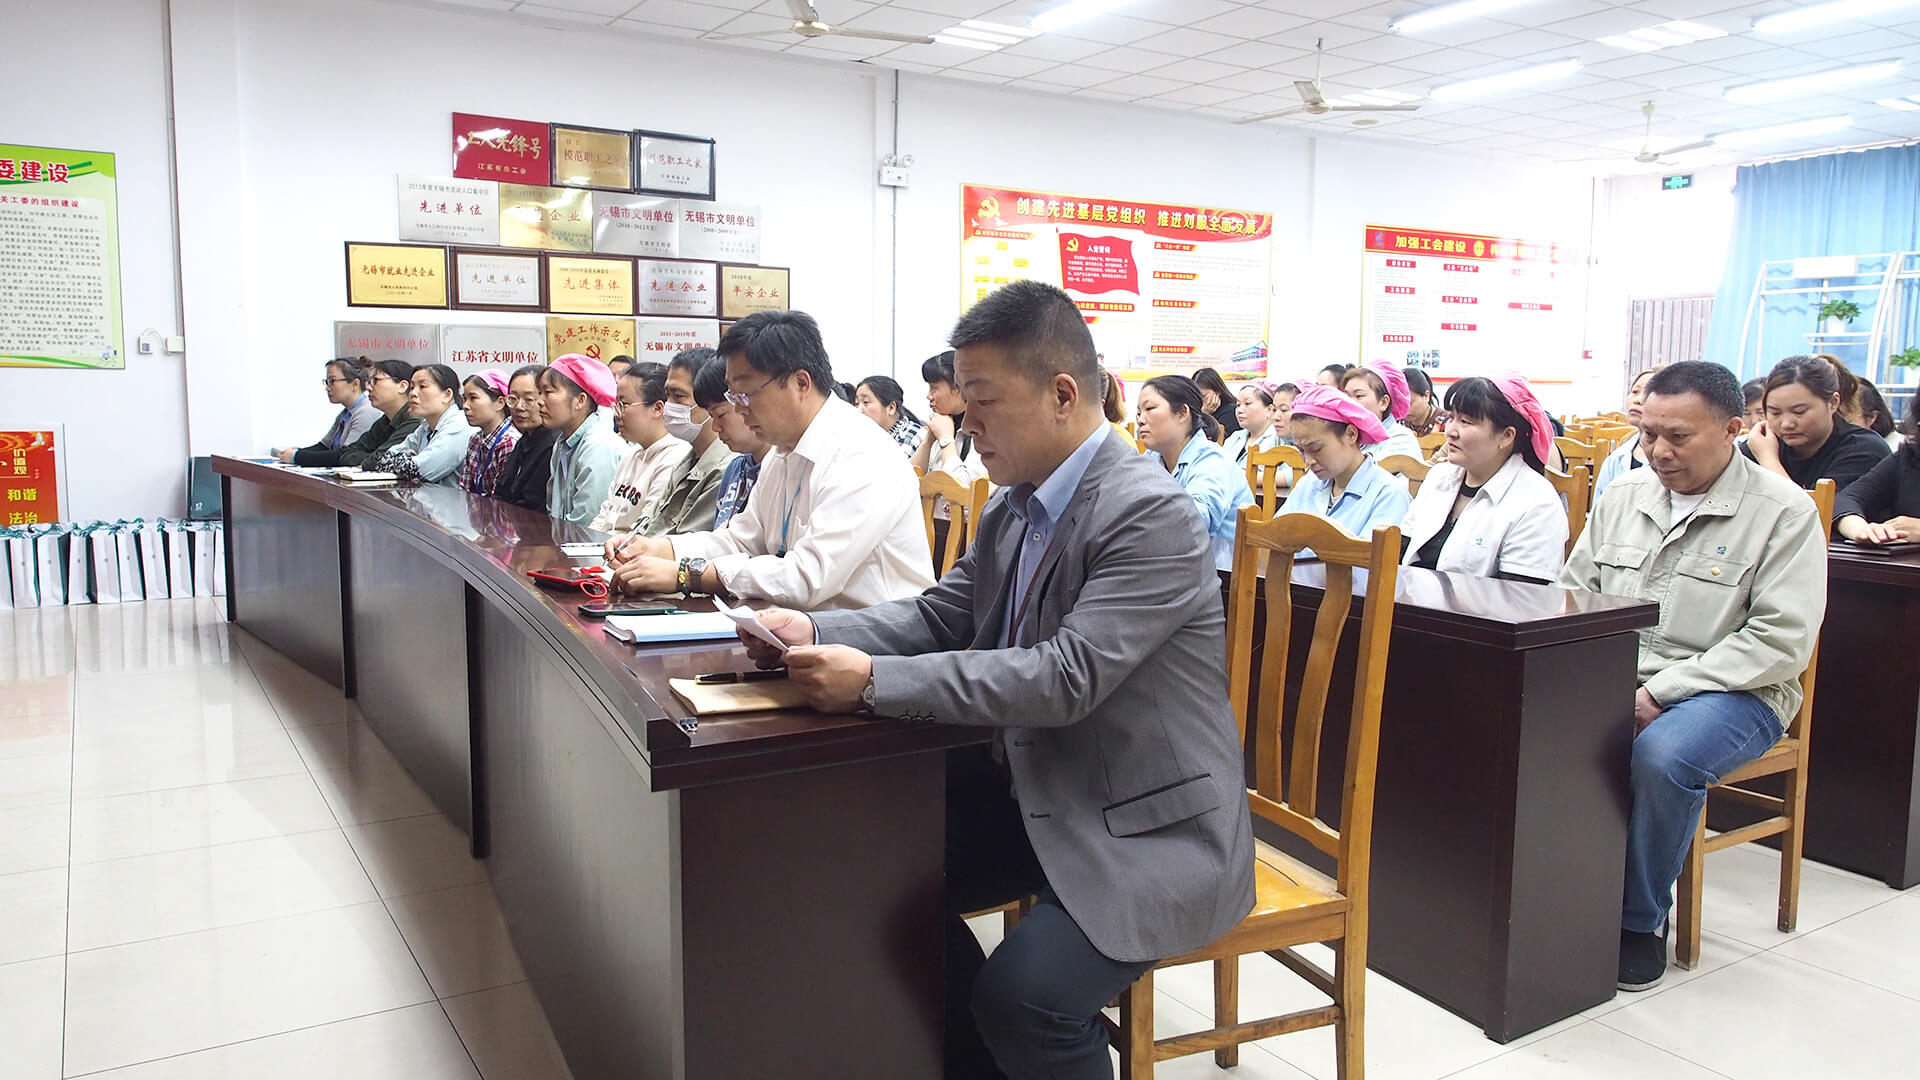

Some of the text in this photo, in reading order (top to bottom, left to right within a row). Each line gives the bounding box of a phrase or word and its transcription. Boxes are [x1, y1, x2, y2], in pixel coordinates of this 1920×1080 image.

[564, 149, 625, 167] 模范职工之
[419, 199, 482, 216] 先进单位
[599, 205, 674, 223] 无锡市文明单位
[685, 210, 756, 228] 无锡市文明单位
[1016, 197, 1258, 236] 创建先进基层党组织 推进刘服全面发展
[1395, 235, 1467, 253] 加强工会建设
[362, 265, 435, 277] 无锡市就业先进企业
[471, 272, 528, 285] 先进单位
[563, 276, 620, 290] 先进集体
[650, 280, 707, 293] 先进企业
[732, 285, 779, 298] 平安企业
[554, 323, 631, 349] 党建工作示范点
[348, 337, 431, 350] 无锡市文明单位
[452, 350, 539, 364] 江苏省文明单位
[13, 448, 27, 475] 价值观
[7, 488, 37, 502] 和谐
[9, 511, 38, 525] 法治
